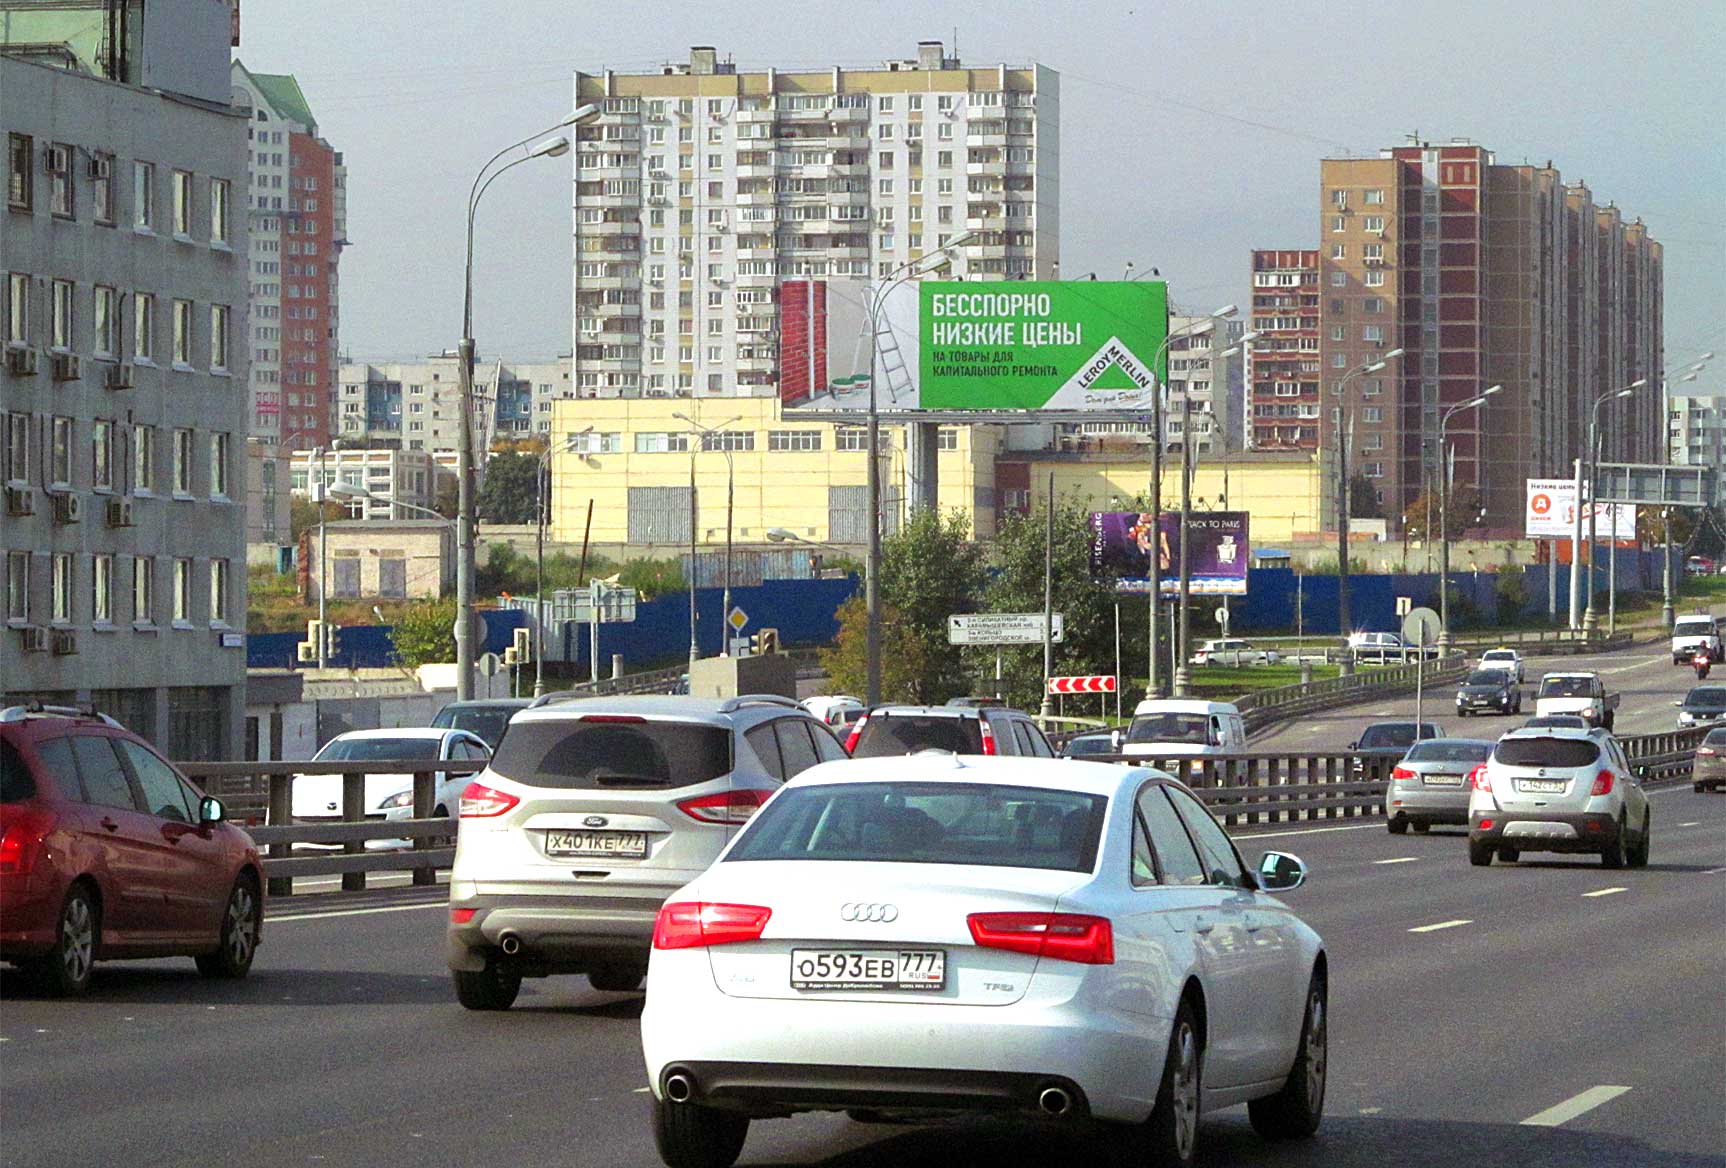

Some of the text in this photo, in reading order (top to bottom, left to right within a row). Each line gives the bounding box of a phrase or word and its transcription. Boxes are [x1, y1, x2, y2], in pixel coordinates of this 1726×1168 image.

[932, 293, 1051, 317] БЕССПОРНО
[932, 322, 1082, 348] НИЗКИЕ ЦЕНЫ
[933, 351, 1013, 363] НА ТОВАРЫ ДЛЯ
[1078, 345, 1150, 388] LEROY MERLIN
[933, 365, 1058, 377] КАПИТАЛЬНОГО РЕМОНТА
[552, 832, 641, 850] Х401КЕ 777
[800, 953, 937, 978] О593ЕВ 777
